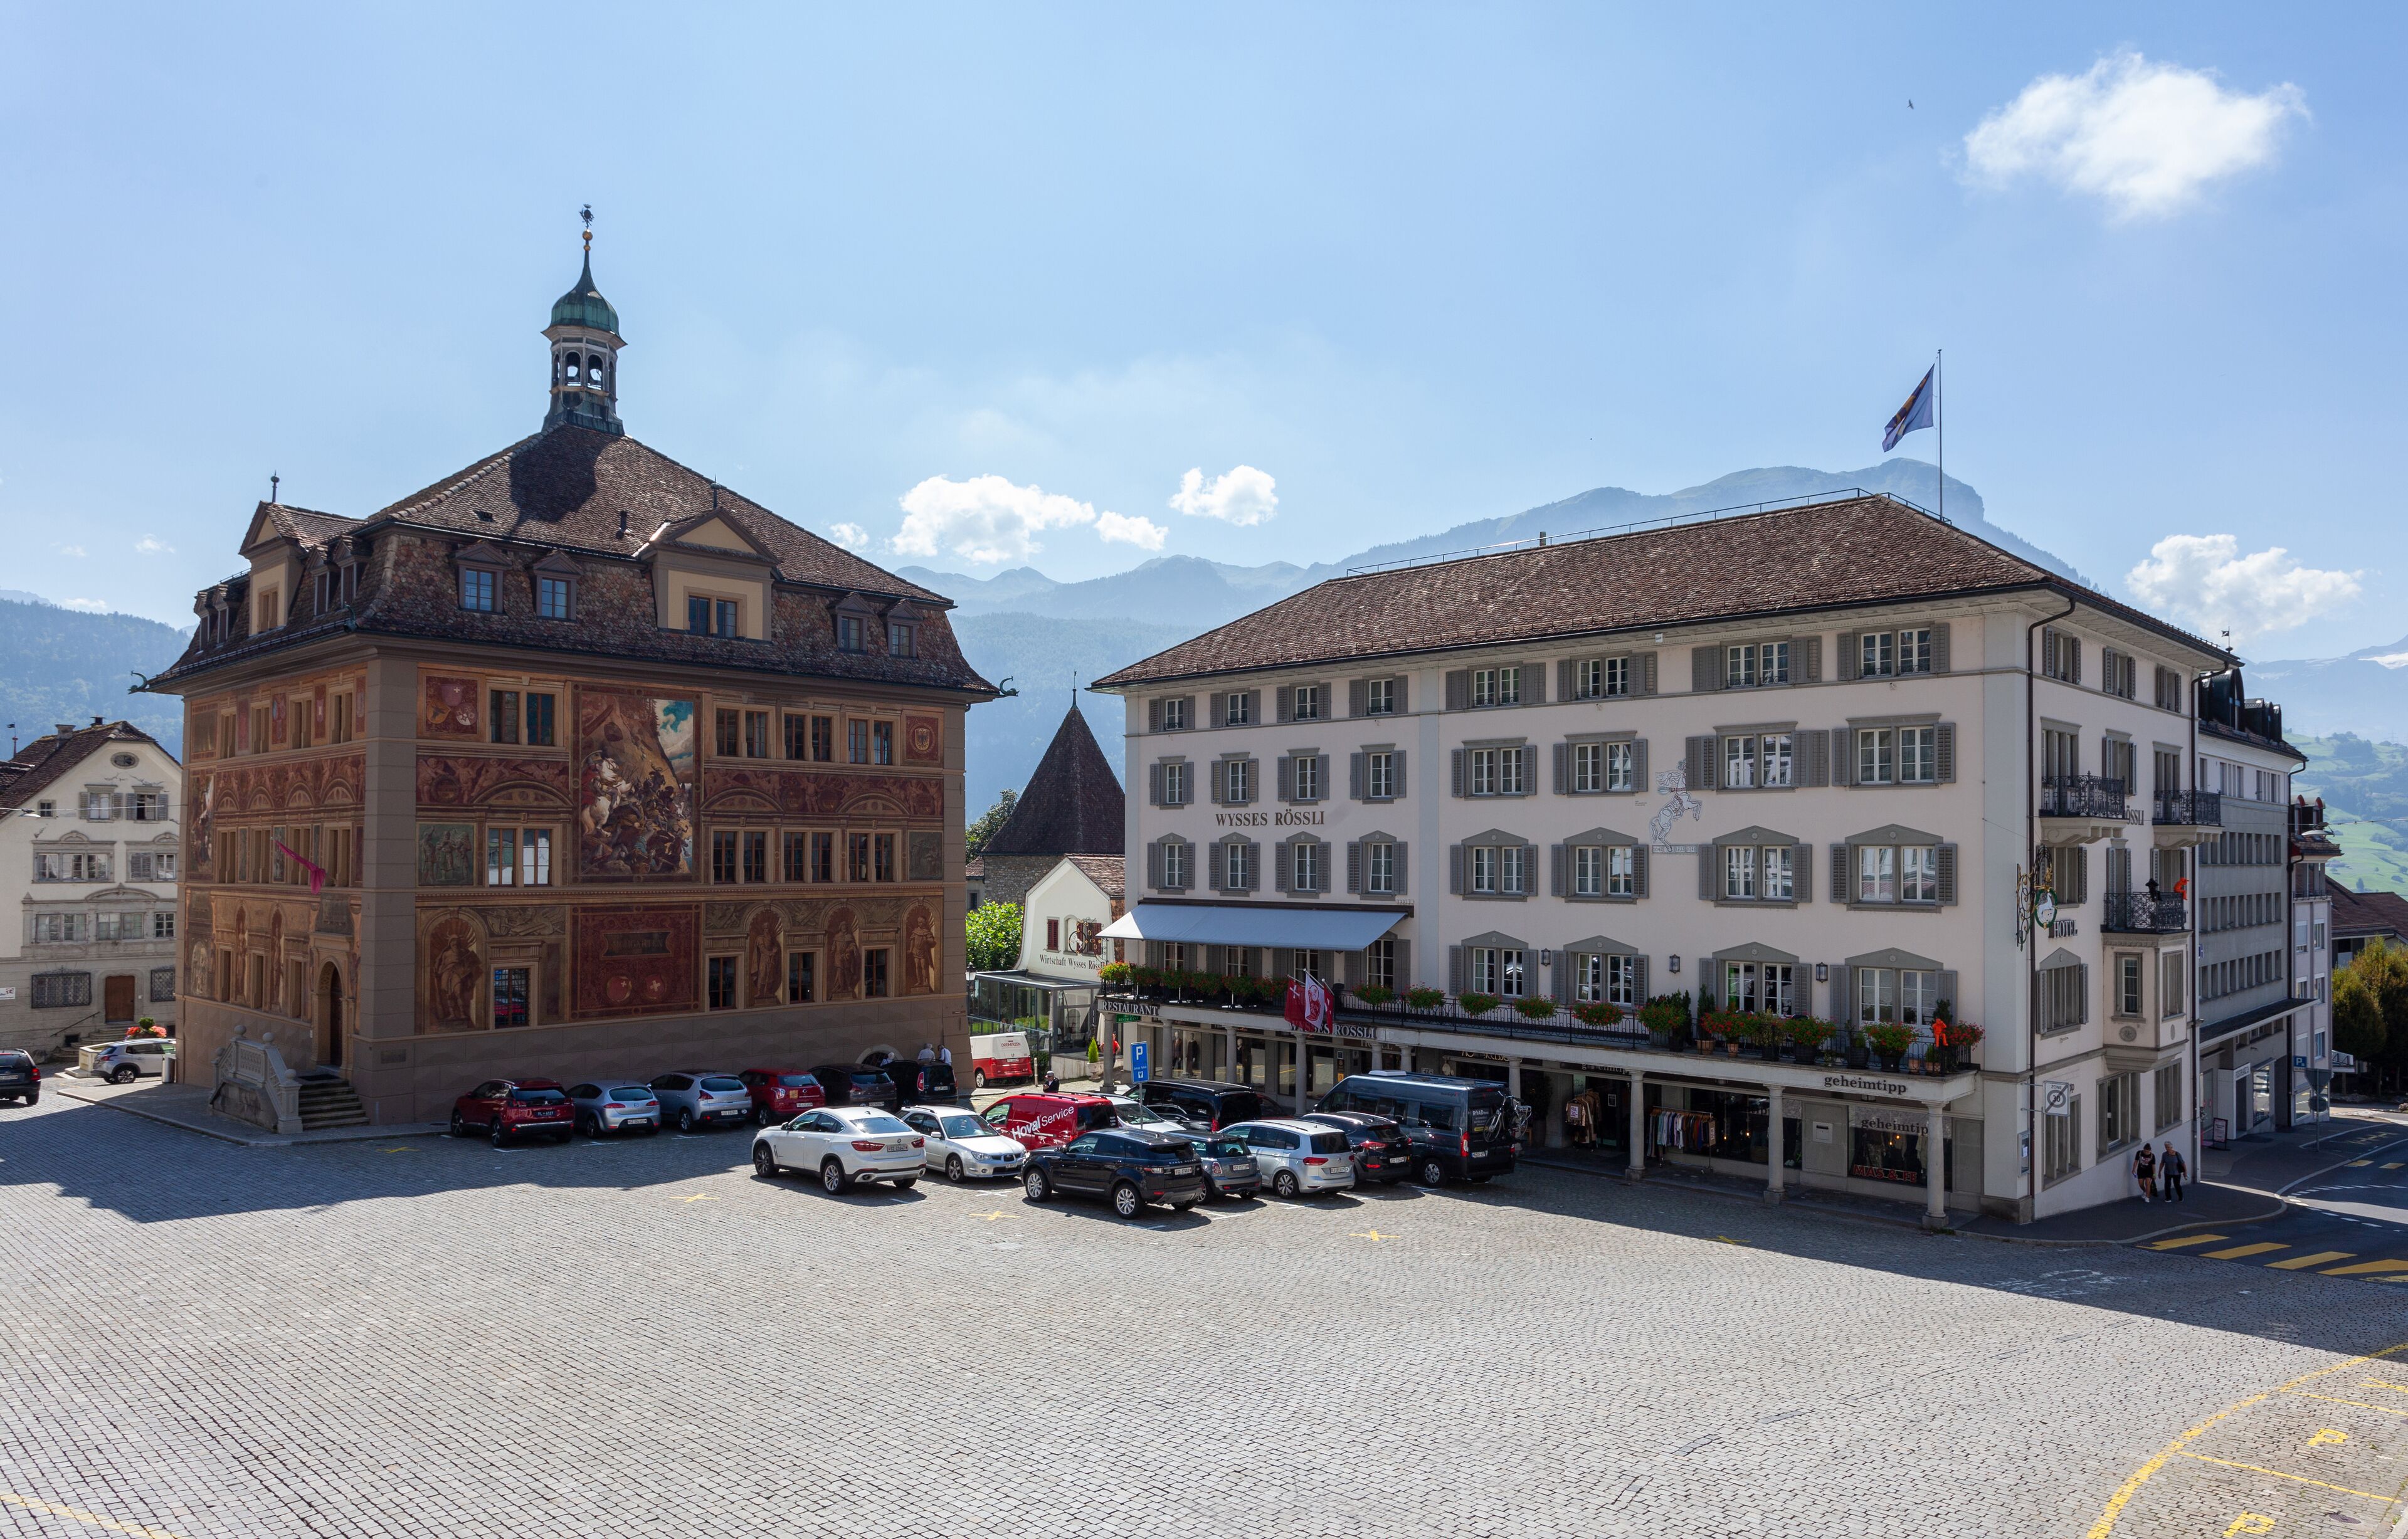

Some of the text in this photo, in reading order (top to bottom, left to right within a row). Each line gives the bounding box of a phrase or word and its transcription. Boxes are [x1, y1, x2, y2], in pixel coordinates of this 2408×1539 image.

[1215, 808, 1325, 826] WYSSES RÖSSLI
[2053, 919, 2078, 938] HOTEL
[1039, 953, 1066, 967] Wirtschaft
[1068, 957, 1086, 969] Wysses
[1102, 1001, 1158, 1016] RESTAURANT
[1136, 1046, 1143, 1061] P
[2296, 1057, 2303, 1066] P
[1824, 1074, 1907, 1095] geheimtipp
[2052, 1095, 2061, 1103] 30
[1011, 1106, 1074, 1141] Hoval Service
[1861, 1118, 1929, 1136] geheimtip
